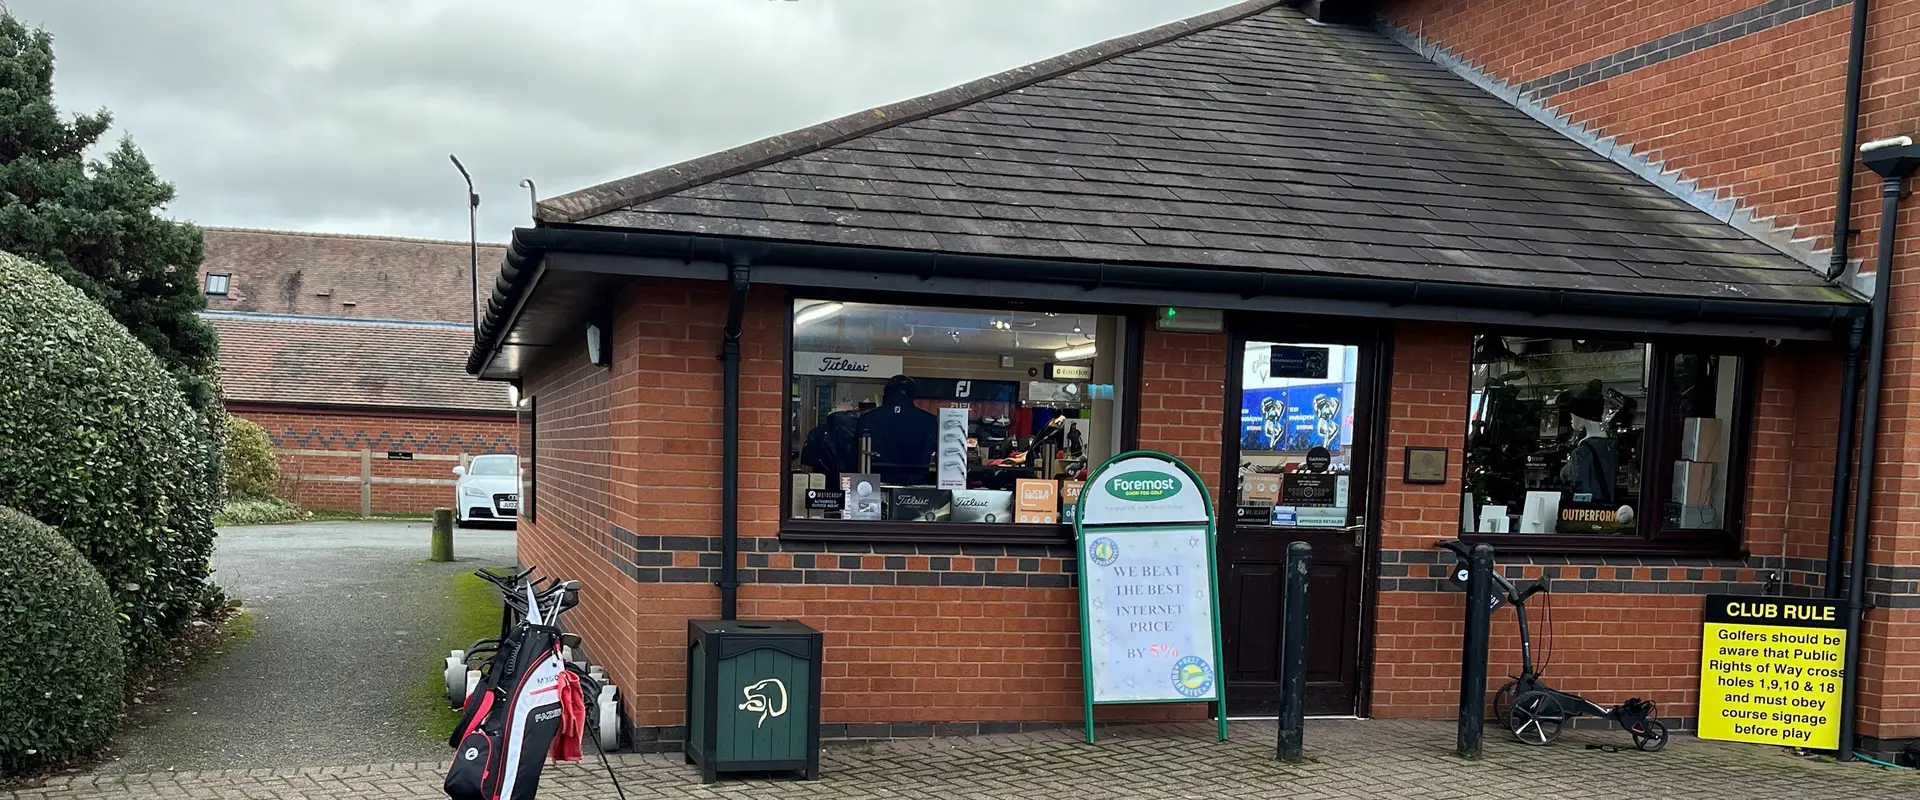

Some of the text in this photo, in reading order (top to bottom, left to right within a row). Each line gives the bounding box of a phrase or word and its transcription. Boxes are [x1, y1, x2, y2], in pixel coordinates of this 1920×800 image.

[818, 356, 870, 373] Titleist
[955, 380, 972, 398] FJ
[1113, 478, 1174, 491] Foremost
[895, 494, 929, 506] Titleist
[953, 496, 989, 508] Titleist
[1562, 508, 1619, 522] OUTPERFORM
[1113, 565, 1182, 577] WE BEAT
[1114, 584, 1183, 596] THE BEST
[1116, 604, 1184, 616] INTERNET
[1726, 602, 1836, 621] CLUB RULE
[1130, 621, 1173, 632] PRICE
[1718, 629, 1841, 646] Golfers should be
[1127, 642, 1179, 658] BY 5%
[1718, 646, 1838, 662] aware that Public
[1709, 660, 1845, 679] Rights of Way cross
[1718, 676, 1835, 693] holes 1,9,10 & 18
[1724, 692, 1826, 711] and must obey
[1721, 709, 1827, 727] course signage
[1734, 723, 1812, 742] before play
